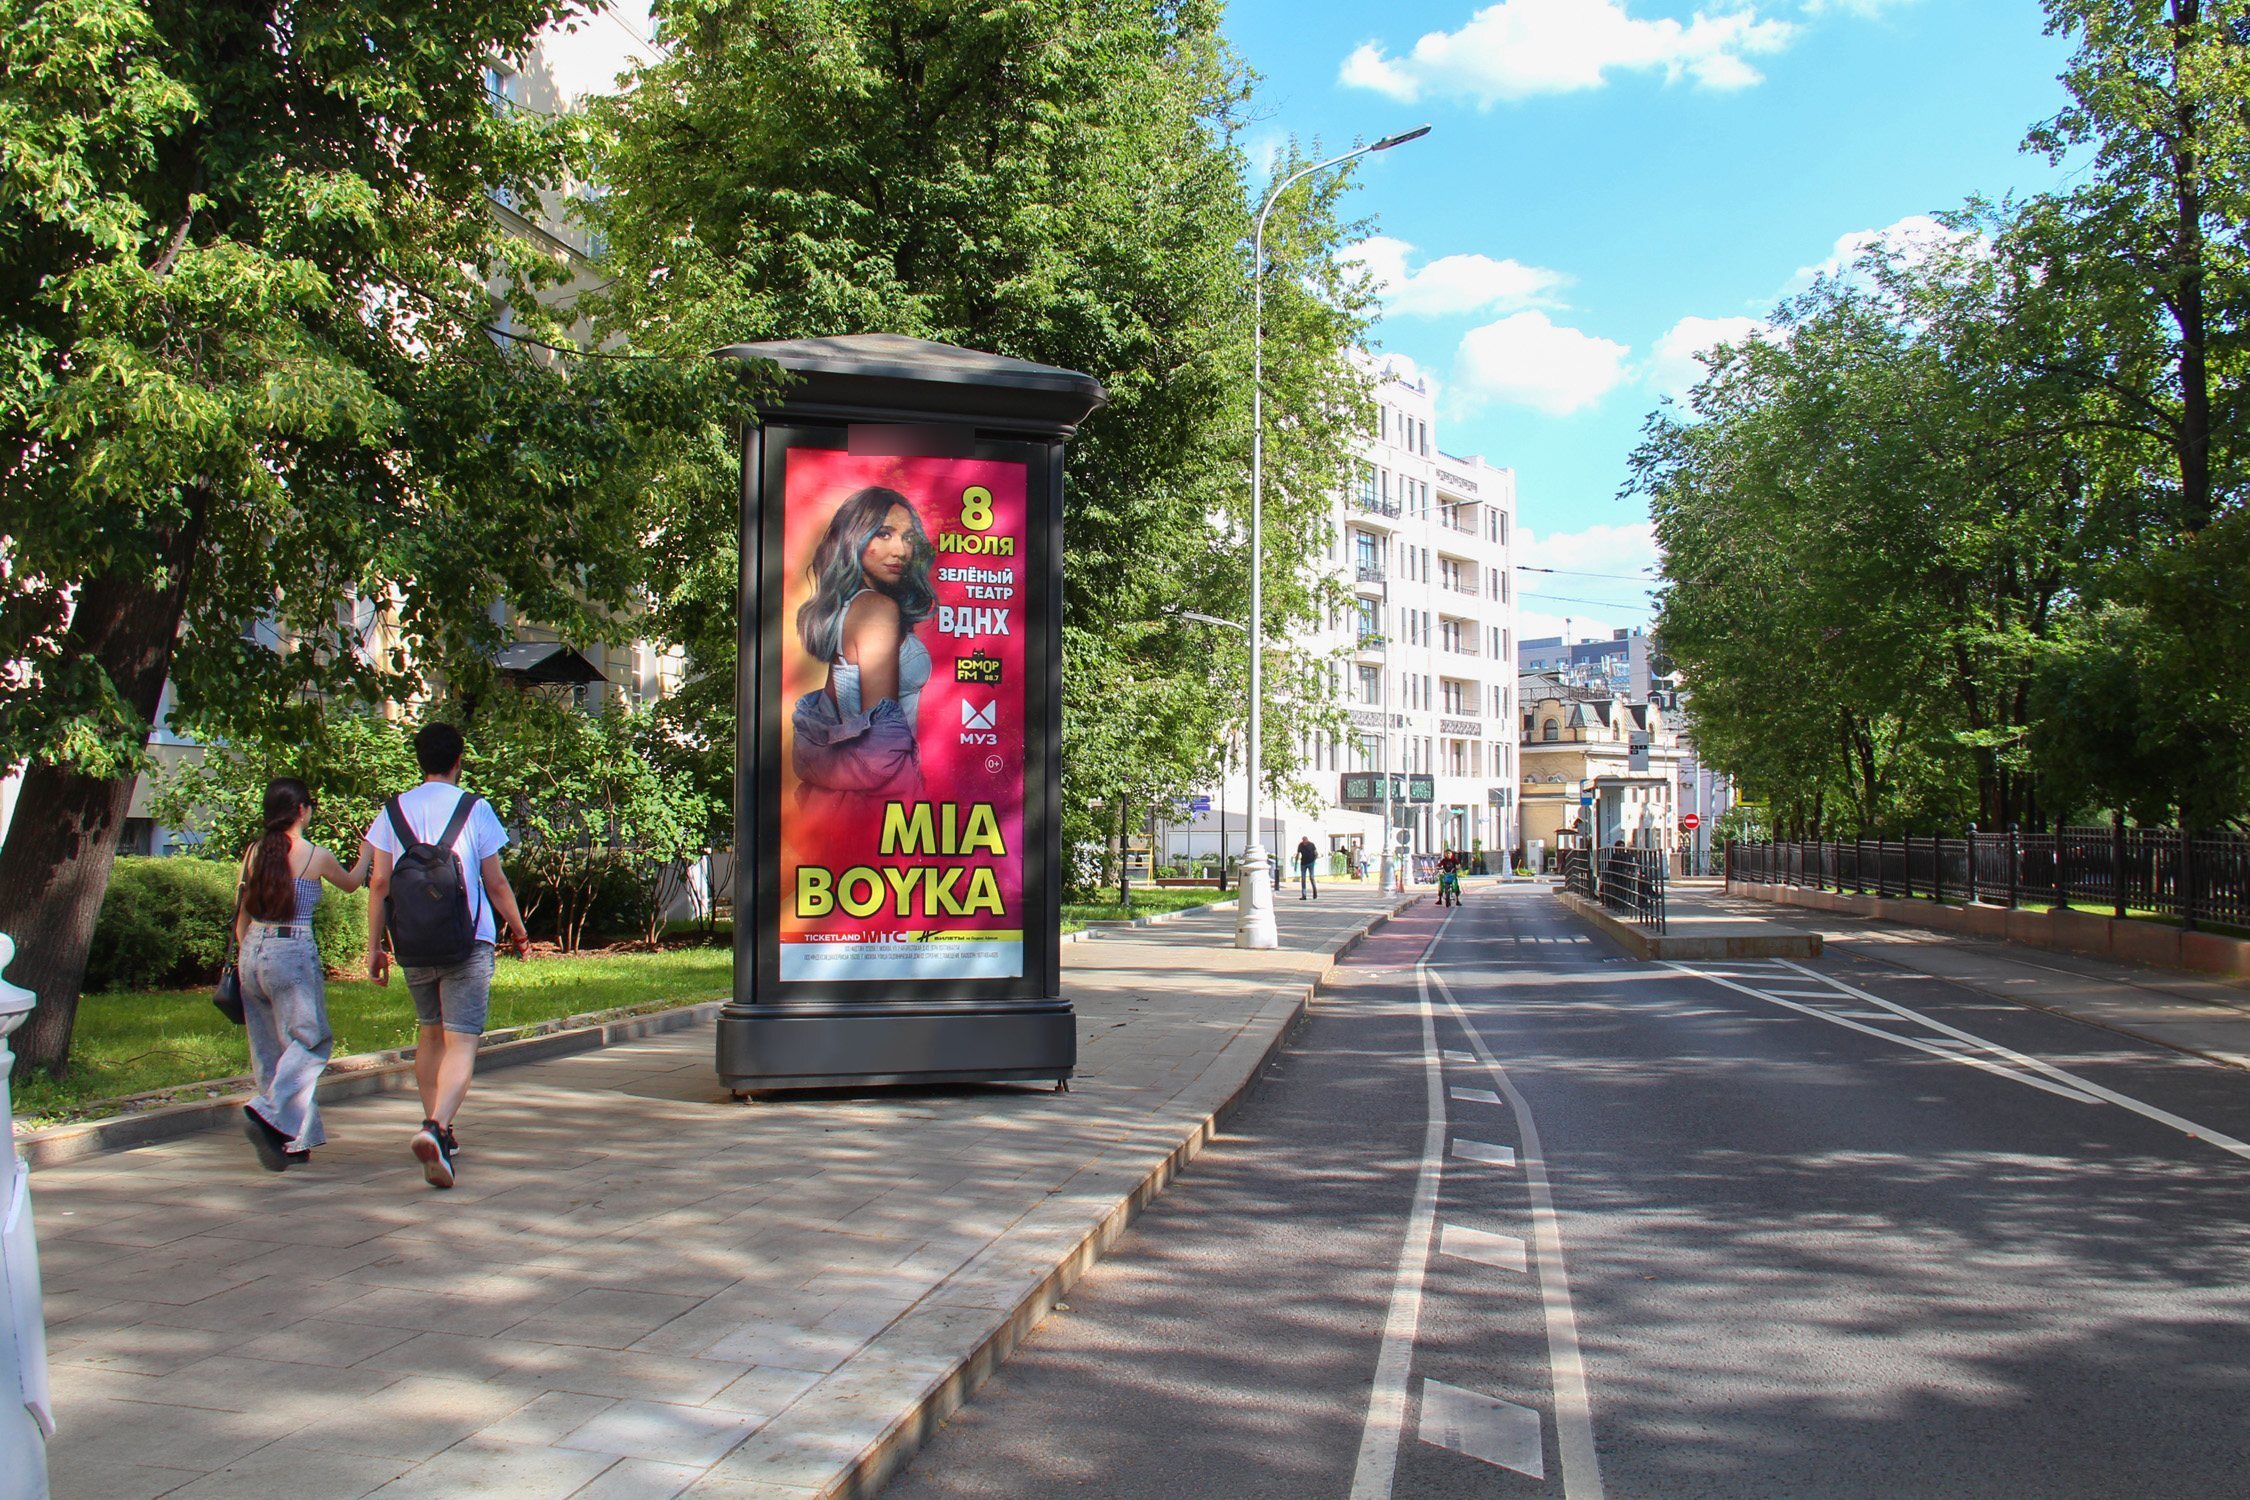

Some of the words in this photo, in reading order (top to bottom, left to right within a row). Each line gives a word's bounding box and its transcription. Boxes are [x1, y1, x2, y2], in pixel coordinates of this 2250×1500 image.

[961, 485, 994, 531] 8
[939, 532, 1014, 556] ИЮЛЯ
[937, 566, 1014, 584] ЗЕЛЁНЫЙ
[965, 585, 1014, 600] ТЕАТР
[938, 605, 1010, 639] ВДНХ
[957, 659, 1000, 674] ЮМОР
[957, 670, 978, 680] FM
[960, 733, 998, 745] МУЗ
[987, 758, 1000, 769] 0+
[879, 802, 1007, 856] MIA
[796, 866, 1006, 918] BOYKA
[804, 934, 861, 942] TICKETLAND
